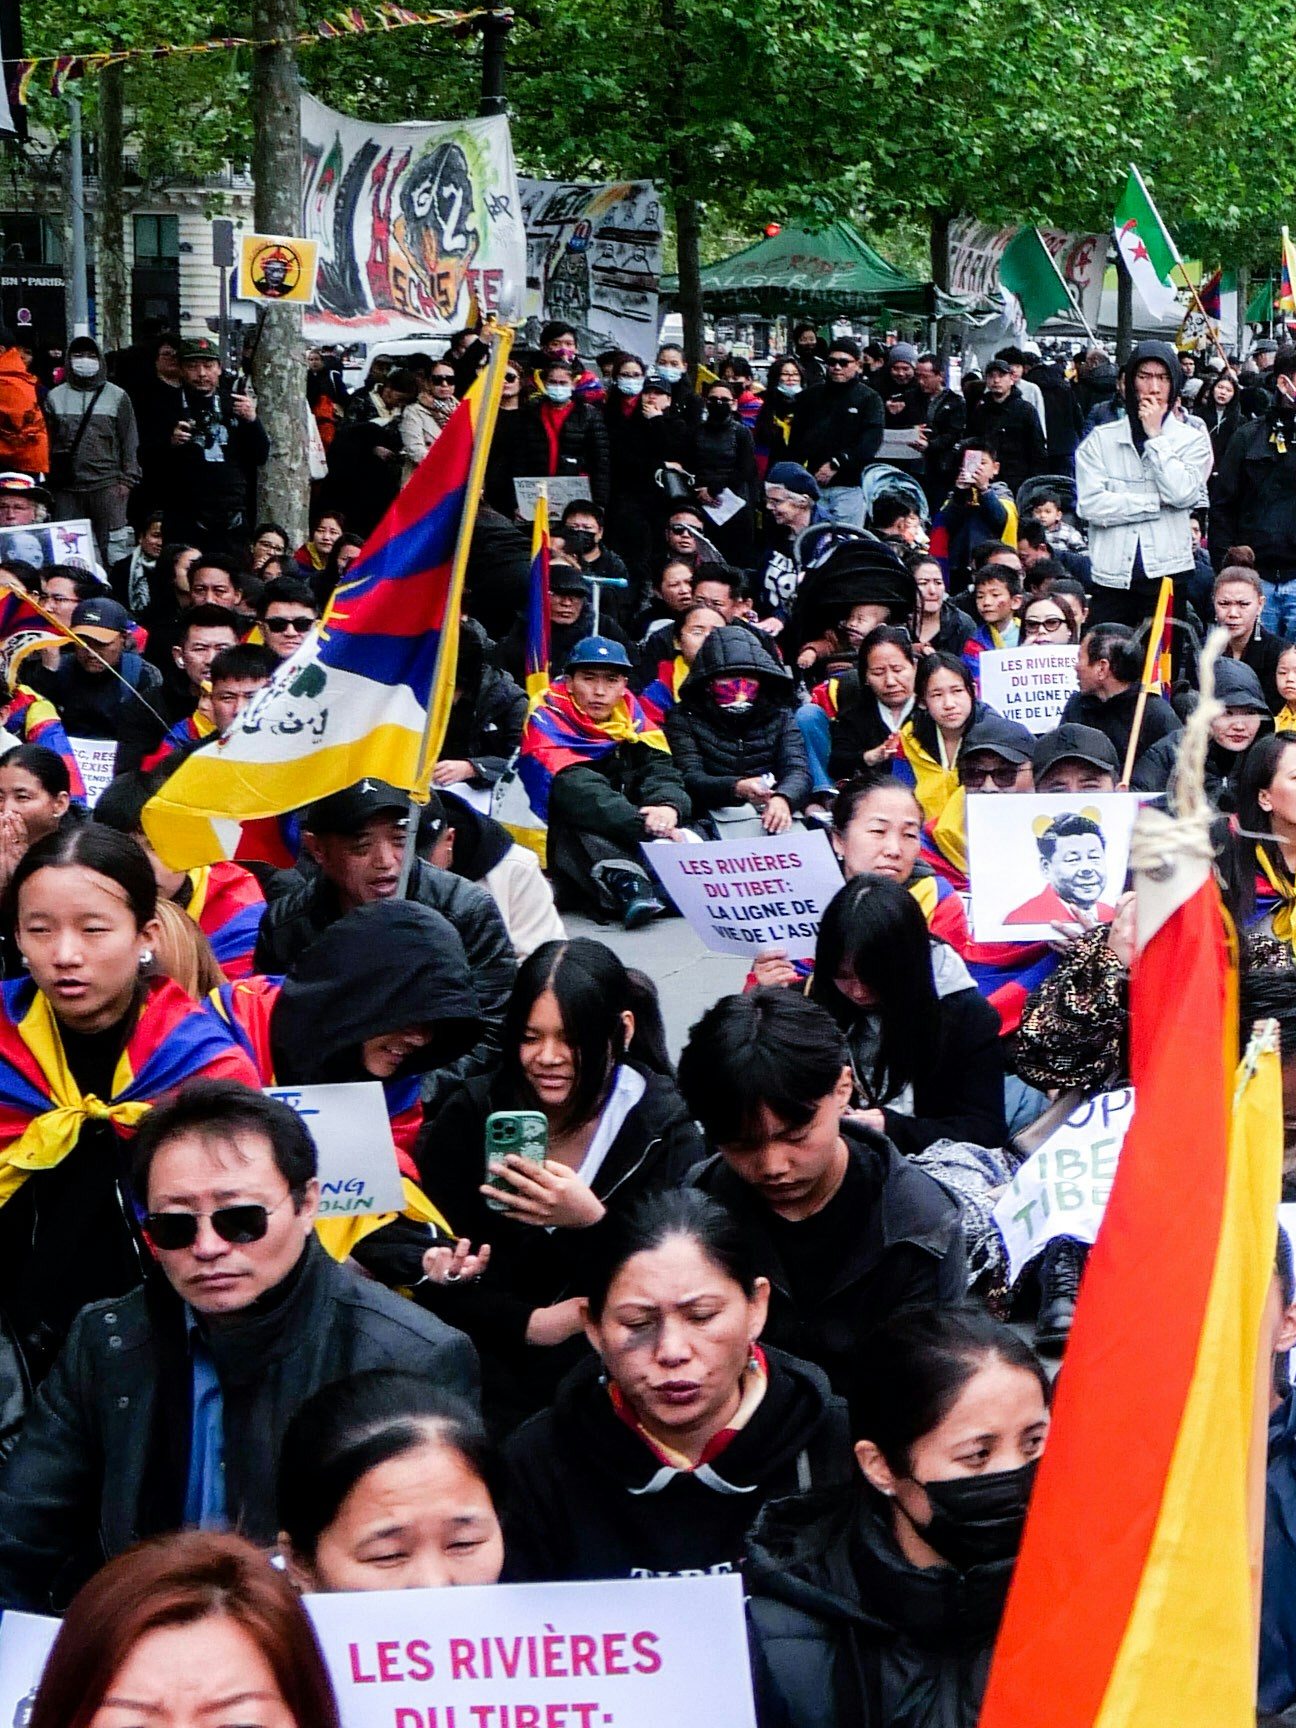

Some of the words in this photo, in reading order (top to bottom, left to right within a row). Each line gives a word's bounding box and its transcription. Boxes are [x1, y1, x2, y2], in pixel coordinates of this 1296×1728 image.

[1001, 660, 1022, 672] LES
[1012, 675, 1028, 686] DU
[1032, 673, 1068, 686] TIBET:
[1006, 693, 1022, 704] LA
[1026, 690, 1060, 702] LIGNE
[1003, 709, 1022, 720] VIE
[1026, 707, 1042, 719] DE
[679, 860, 714, 875] LES
[716, 852, 803, 874] RIVIÈRES
[704, 883, 730, 898] DU
[731, 879, 794, 898] TIBET:
[706, 905, 731, 921] LA
[731, 901, 790, 921] LIGNE
[791, 899, 819, 915] DE
[712, 924, 742, 941] VIE
[742, 927, 768, 943] DE
[348, 1637, 435, 1685] LES
[451, 1622, 663, 1680] RIVIÈRES
